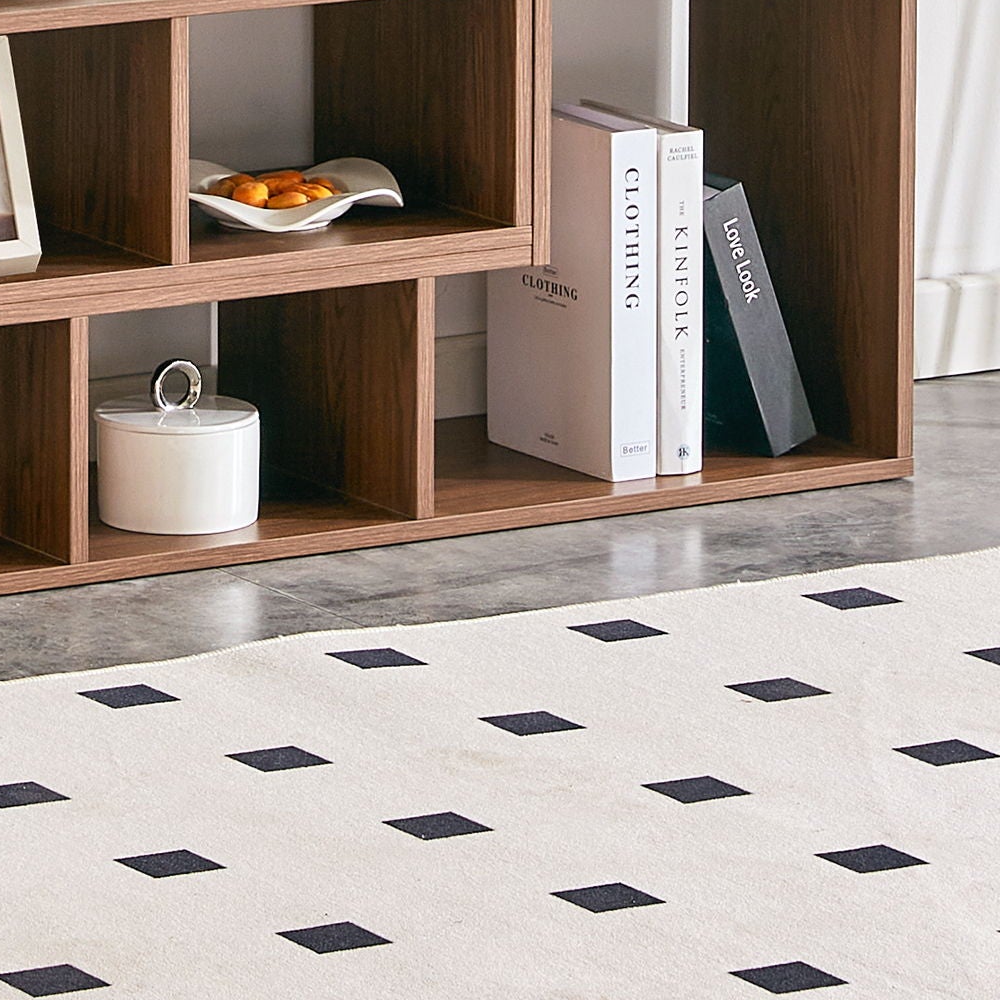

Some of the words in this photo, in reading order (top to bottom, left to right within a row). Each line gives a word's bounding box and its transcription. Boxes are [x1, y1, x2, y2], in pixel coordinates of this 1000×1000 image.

[669, 145, 695, 154] RACHEL
[624, 167, 640, 310] CLOTHING
[722, 217, 745, 260] Love
[735, 259, 761, 304] Look
[521, 273, 578, 302] CLOTHING
[674, 226, 689, 341] KINFOLK
[622, 444, 648, 455] Better
